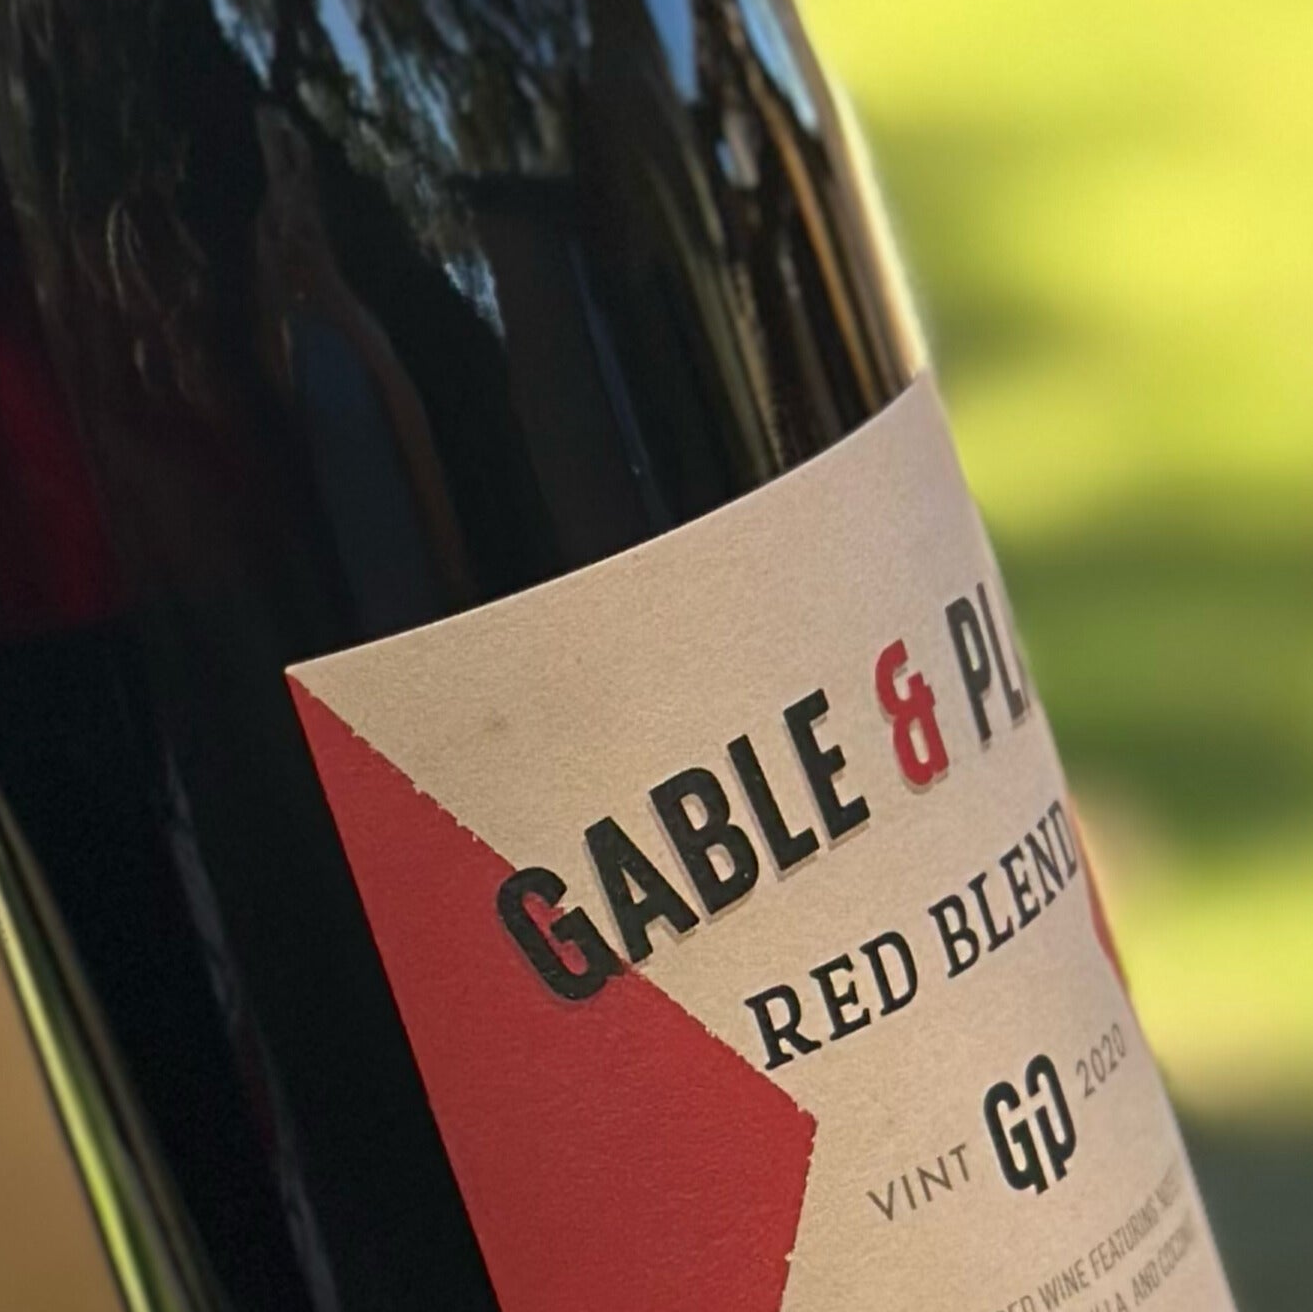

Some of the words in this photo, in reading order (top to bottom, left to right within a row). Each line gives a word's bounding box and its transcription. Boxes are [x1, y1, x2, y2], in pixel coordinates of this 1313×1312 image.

[495, 687, 871, 1002] GABLE
[875, 638, 951, 788] &
[944, 581, 1032, 750] PL
[743, 930, 920, 1071] RED
[927, 799, 1079, 980] BLEND
[866, 1143, 972, 1222] VINT
[1076, 1022, 1127, 1098] 2020
